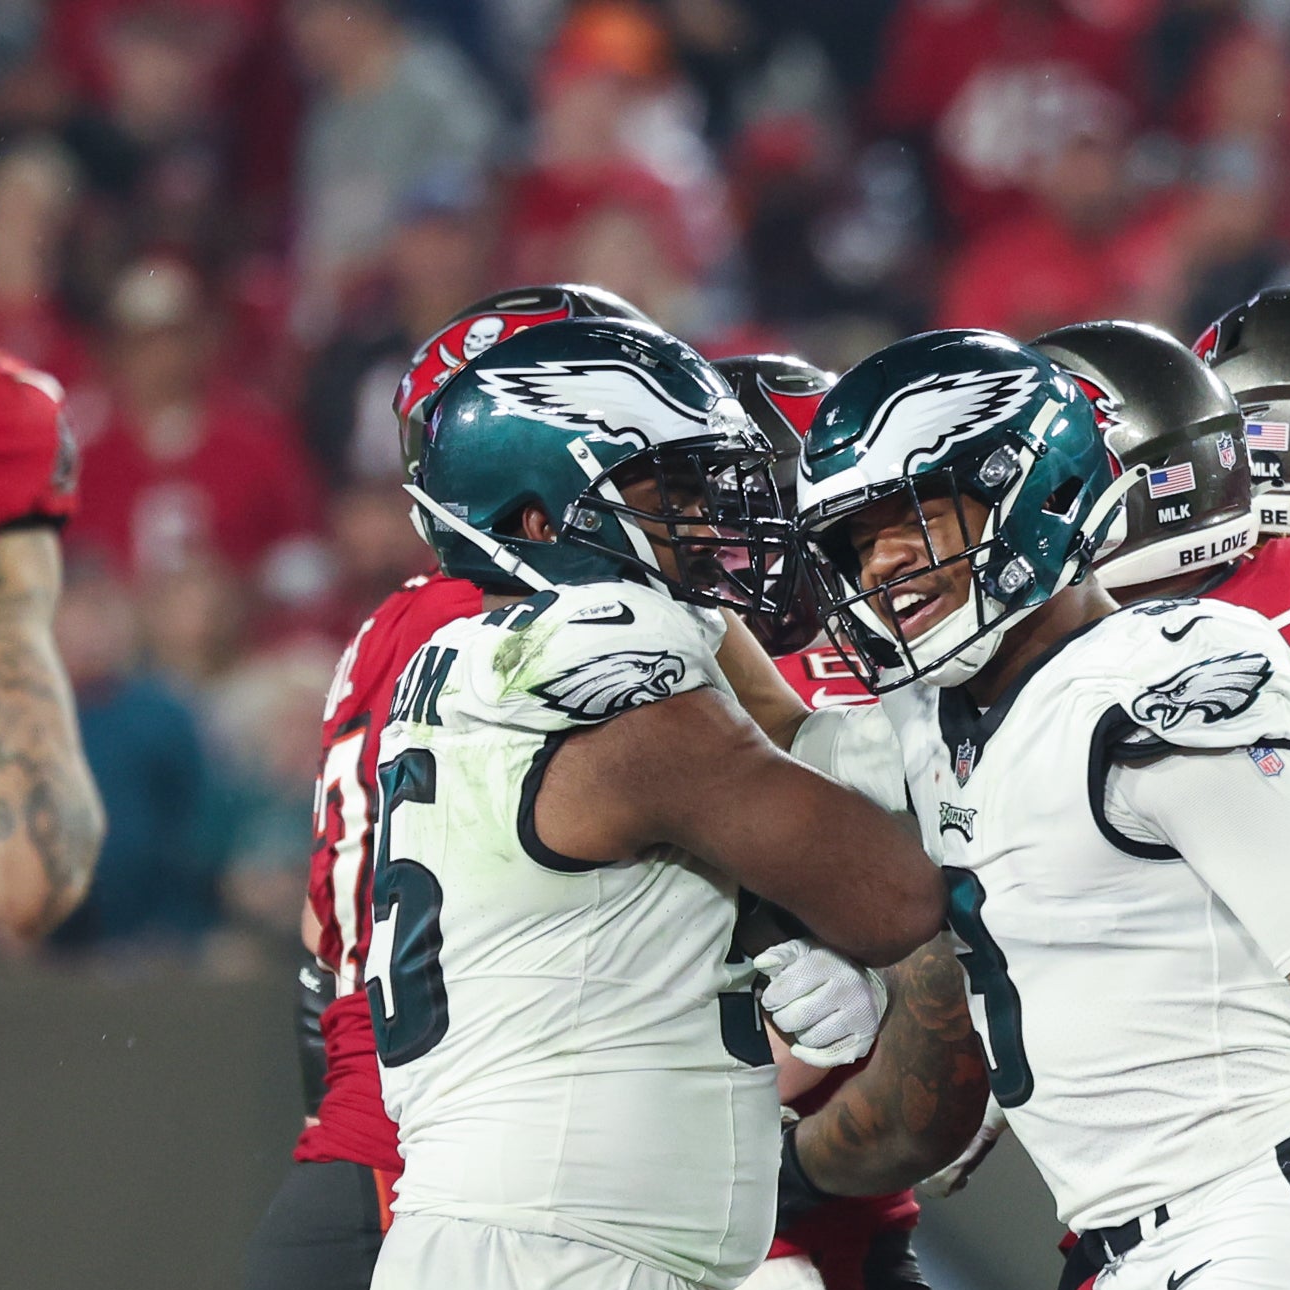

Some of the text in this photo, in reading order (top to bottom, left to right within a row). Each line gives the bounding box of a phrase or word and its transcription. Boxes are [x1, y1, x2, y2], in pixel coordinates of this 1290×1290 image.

[1250, 462, 1281, 478] MLK
[1157, 503, 1191, 524] MLK
[1260, 509, 1288, 526] BE
[1179, 530, 1249, 567] BE LOVE
